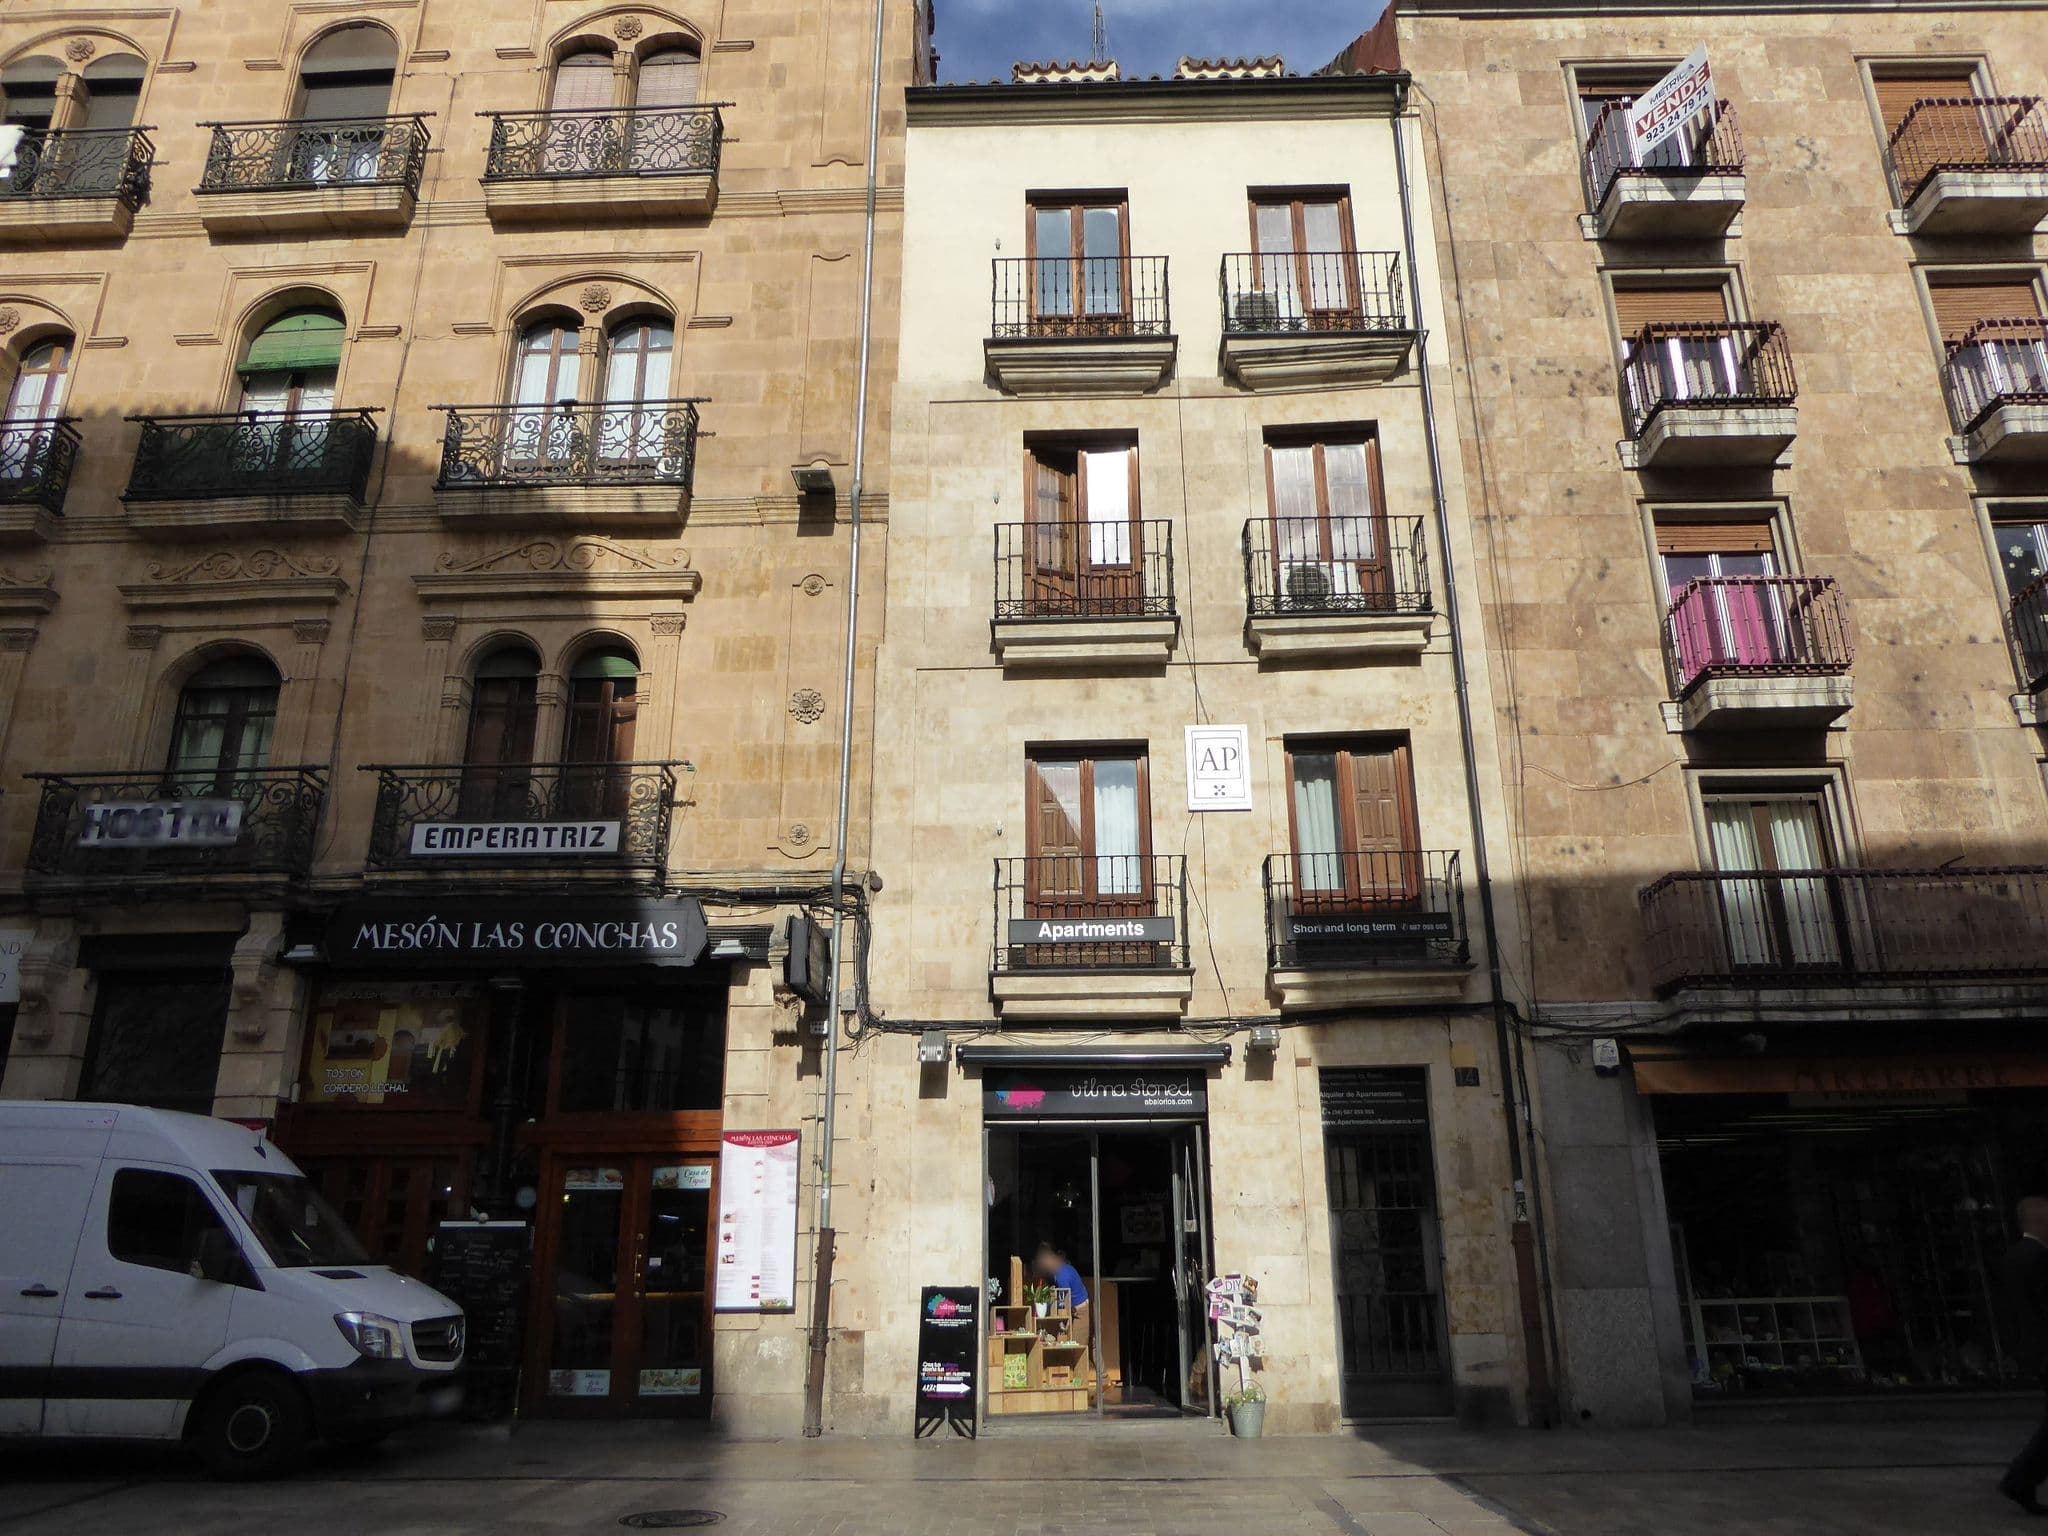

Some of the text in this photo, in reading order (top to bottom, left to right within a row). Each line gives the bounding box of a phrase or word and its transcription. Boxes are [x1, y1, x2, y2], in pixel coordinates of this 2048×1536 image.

[1639, 65, 1709, 130] VENDE
[1646, 86, 1708, 142] 923 24 79 71
[1199, 746, 1237, 772] AP
[424, 825, 606, 850] EMPERATRIZ
[352, 915, 679, 950] MESÓN LAS CONCHAS
[1038, 919, 1145, 942] Apartments
[1293, 923, 1322, 934] Short
[1325, 923, 1344, 933] and
[1347, 922, 1370, 934] long
[1372, 923, 1396, 932] term
[1070, 1077, 1192, 1097] vilma stoned
[1225, 1280, 1242, 1291] DIY
